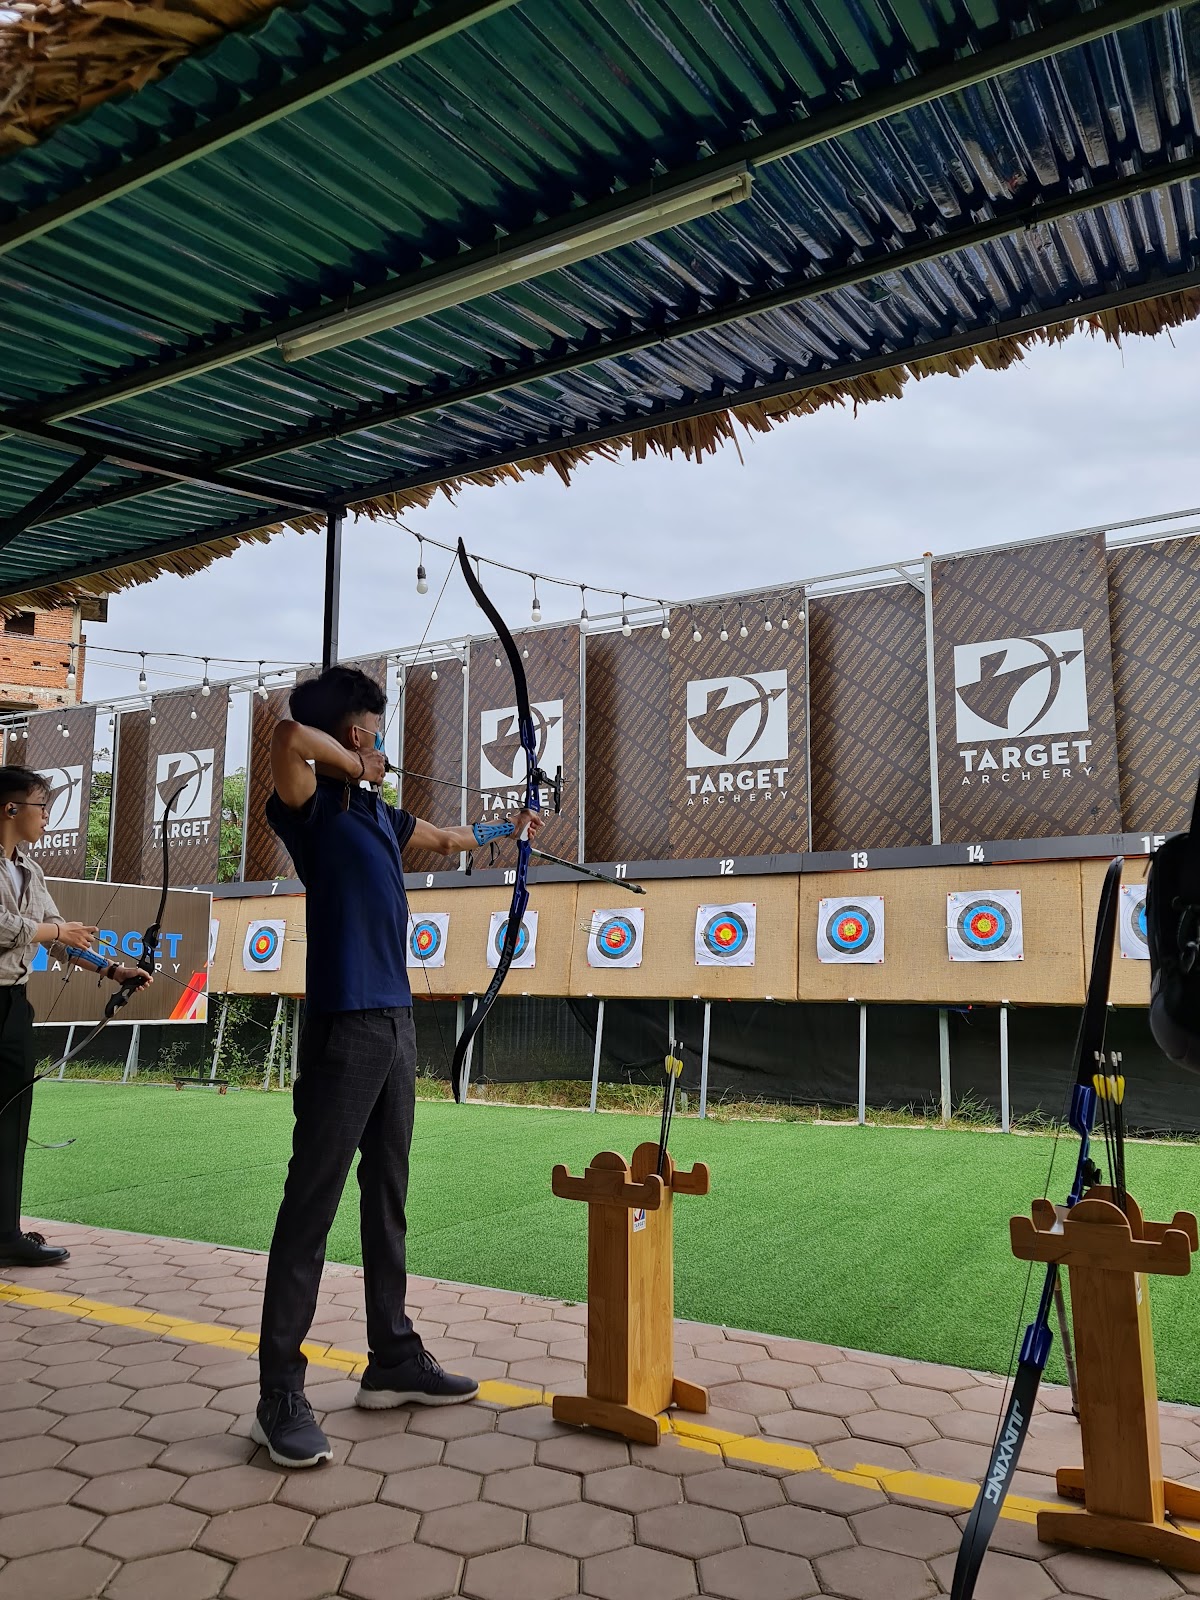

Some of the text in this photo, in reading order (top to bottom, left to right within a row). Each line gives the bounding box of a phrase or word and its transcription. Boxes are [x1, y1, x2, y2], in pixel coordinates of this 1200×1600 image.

[959, 739, 1093, 772] TARGET
[686, 767, 789, 795] TARGET
[961, 766, 1093, 786] ARCHERY
[687, 790, 788, 806] ARCHERY
[480, 808, 562, 822] ARCR
[850, 851, 869, 869] 13
[966, 844, 986, 863] 14
[614, 863, 628, 879] 11
[718, 859, 735, 875] 12
[425, 873, 435, 888] 9
[503, 869, 517, 885] 10
[270, 882, 279, 895] 7
[984, 1398, 1024, 1505] JUNXING
